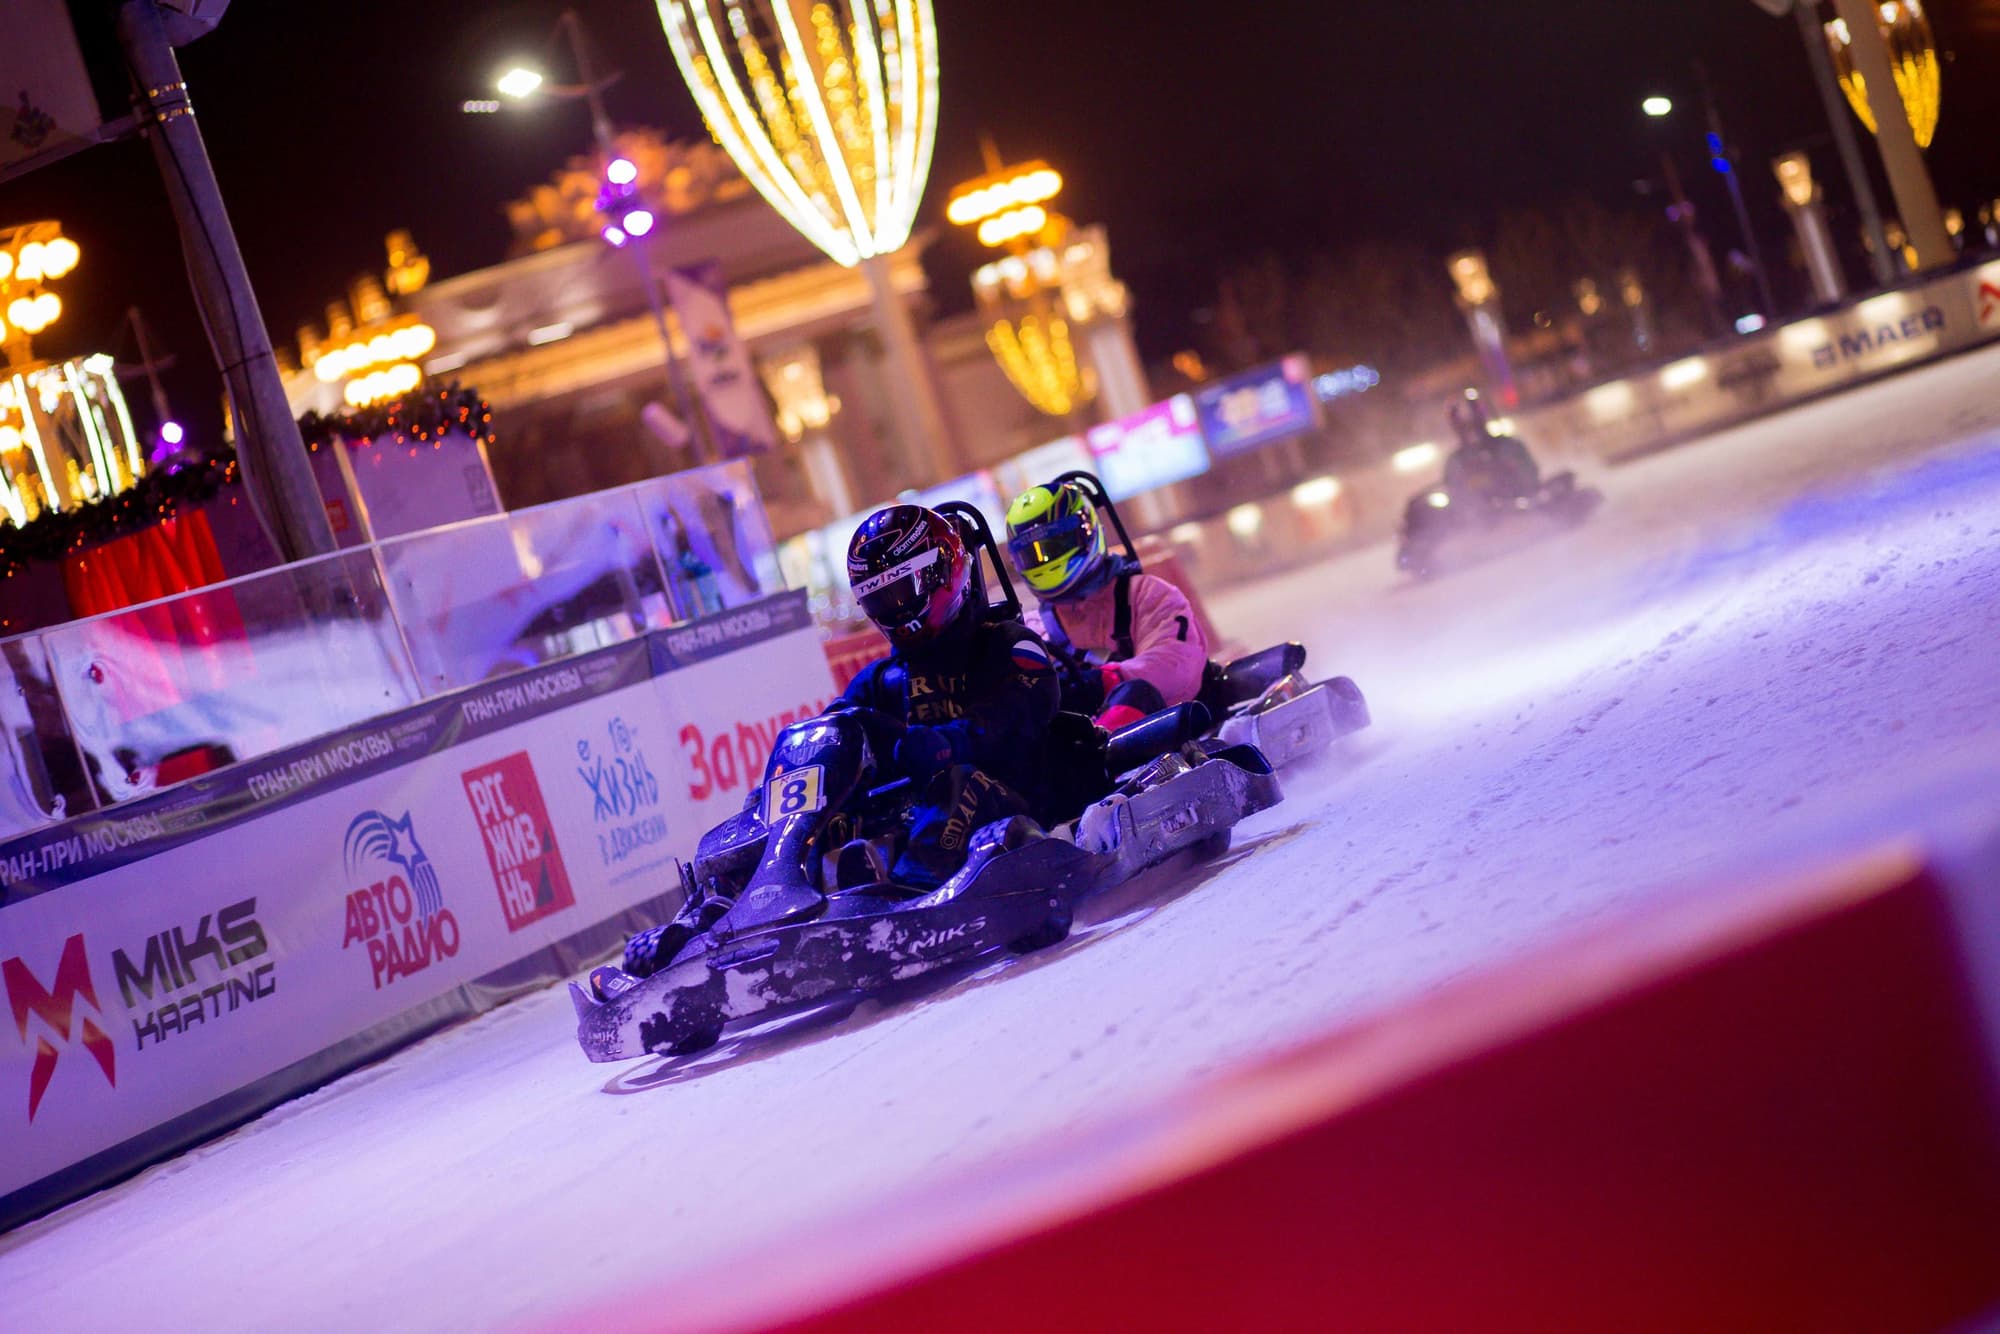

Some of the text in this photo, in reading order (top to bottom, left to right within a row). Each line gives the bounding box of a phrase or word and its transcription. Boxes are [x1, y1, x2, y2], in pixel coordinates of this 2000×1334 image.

[860, 562, 912, 593] TWINS
[462, 684, 526, 725] ГРАН-ПРИ
[523, 668, 582, 705] МОСКВЫ
[248, 756, 327, 801] ГРАН-ПРИ
[325, 731, 393, 774] МОСКВЫ
[577, 750, 658, 822] ЖИЗНЬ
[469, 771, 515, 826] РГС
[780, 779, 807, 814] 8
[83, 811, 164, 858] МОСКВЫ
[485, 812, 541, 873] ЖИЗ
[343, 875, 412, 949] АВТО
[500, 868, 538, 920] НЬ
[112, 897, 267, 1009] MIKS
[367, 908, 460, 990] РАДИО
[908, 916, 987, 955] MIKS
[133, 962, 276, 1051] KARTING
